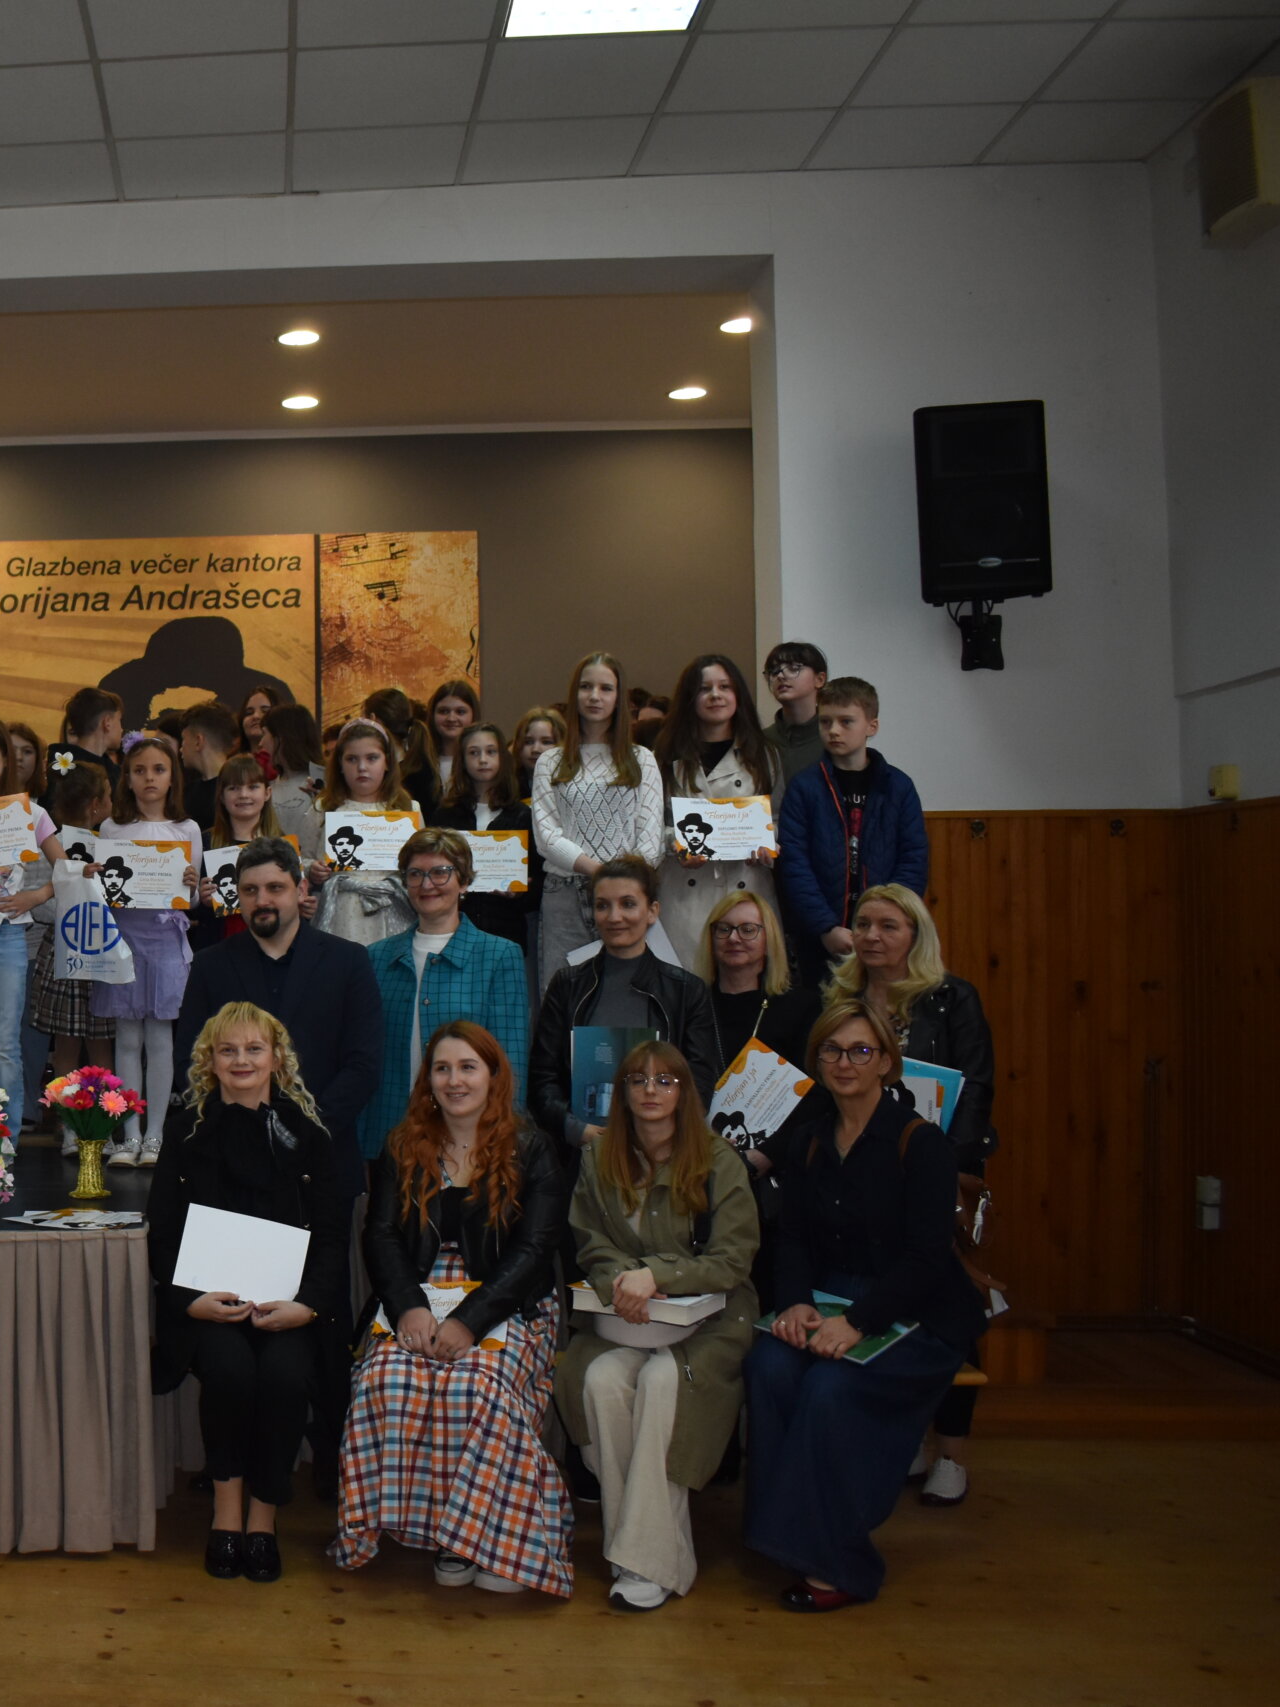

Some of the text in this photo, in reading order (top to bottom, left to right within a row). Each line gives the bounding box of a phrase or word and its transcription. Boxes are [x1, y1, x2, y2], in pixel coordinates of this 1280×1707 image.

[6, 552, 302, 577] Glazbena večer kantora
[120, 583, 302, 611] Andrašeca
